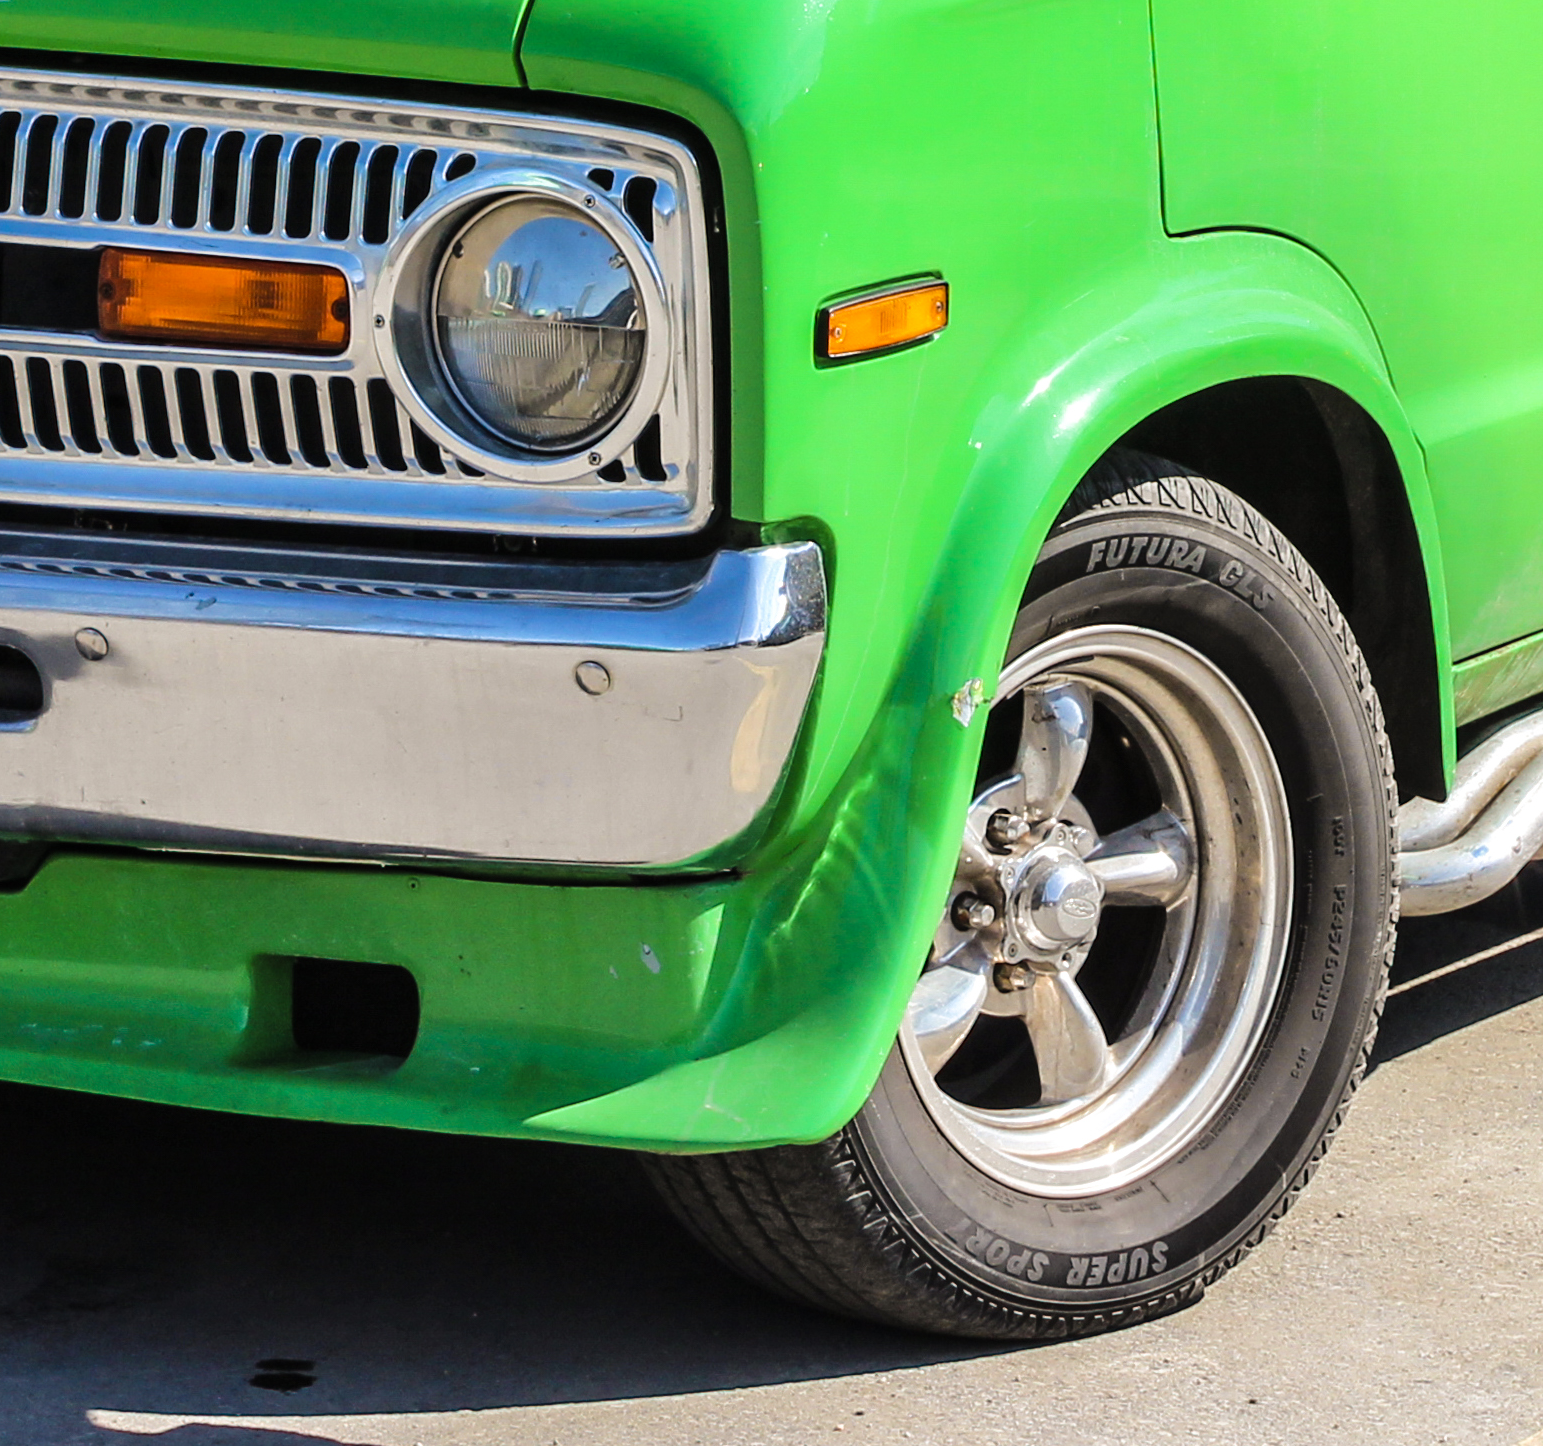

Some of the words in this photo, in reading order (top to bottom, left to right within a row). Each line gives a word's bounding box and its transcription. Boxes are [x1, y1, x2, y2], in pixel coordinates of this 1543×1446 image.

[1086, 536, 1208, 574] FUTURA
[1219, 559, 1276, 613] GLS
[1066, 1240, 1169, 1287] SUPER
